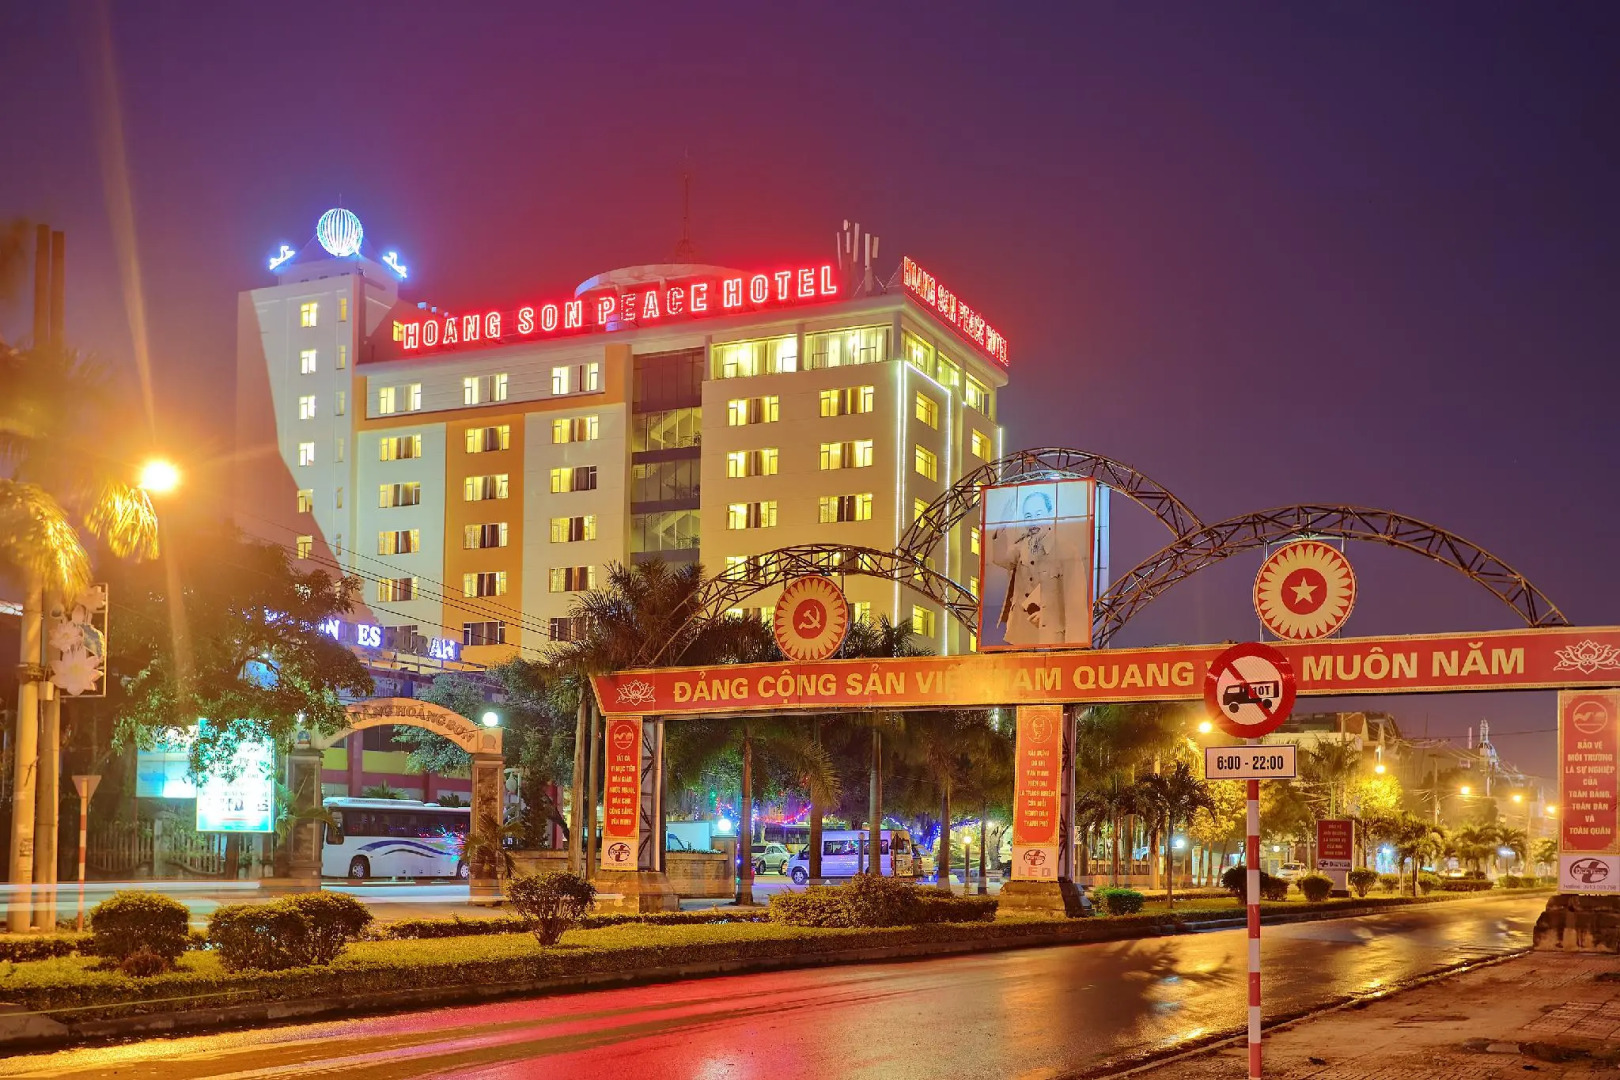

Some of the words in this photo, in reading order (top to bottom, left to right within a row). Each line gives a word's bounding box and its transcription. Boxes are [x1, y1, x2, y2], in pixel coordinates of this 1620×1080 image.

[403, 312, 502, 349] HOANG
[517, 300, 583, 334] SON
[598, 282, 708, 325] PEACE
[723, 265, 838, 308] HOTEL
[673, 671, 749, 703] ĐẢNG
[757, 669, 837, 704] CỘNG
[845, 663, 905, 696] SẢN
[1072, 661, 1194, 690] QUANG
[1302, 646, 1418, 682] MUÔN
[1432, 641, 1525, 677] NĂM
[1216, 755, 1241, 770] 6:00
[1252, 754, 1284, 770] 22:00
